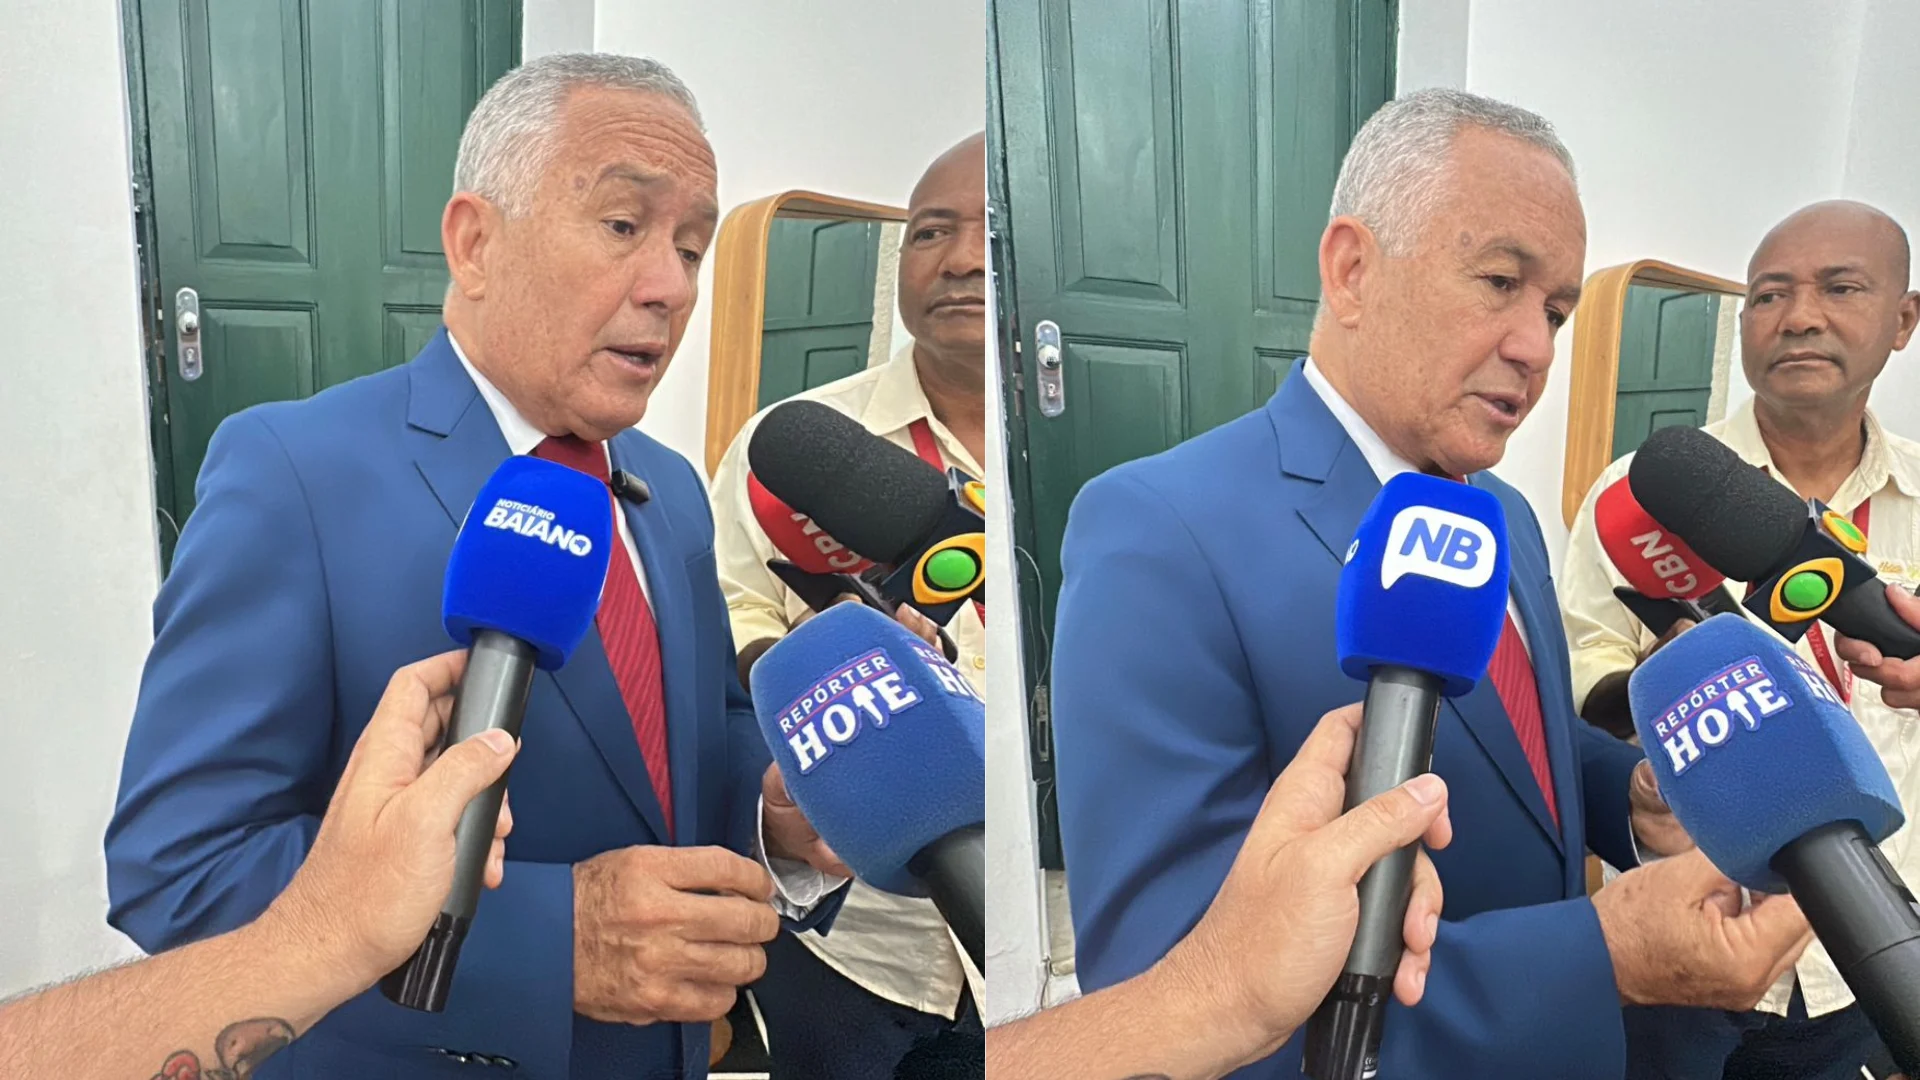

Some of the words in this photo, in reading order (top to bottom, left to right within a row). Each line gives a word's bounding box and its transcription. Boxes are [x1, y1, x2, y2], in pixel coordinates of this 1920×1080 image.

[483, 506, 592, 556] BAIANO
[495, 498, 556, 521] NOTICIÁRIO
[1399, 517, 1483, 571] NB
[1629, 529, 1698, 594] CBN
[779, 655, 891, 734] REPÓRTER
[1655, 663, 1764, 737] REPÓRTER
